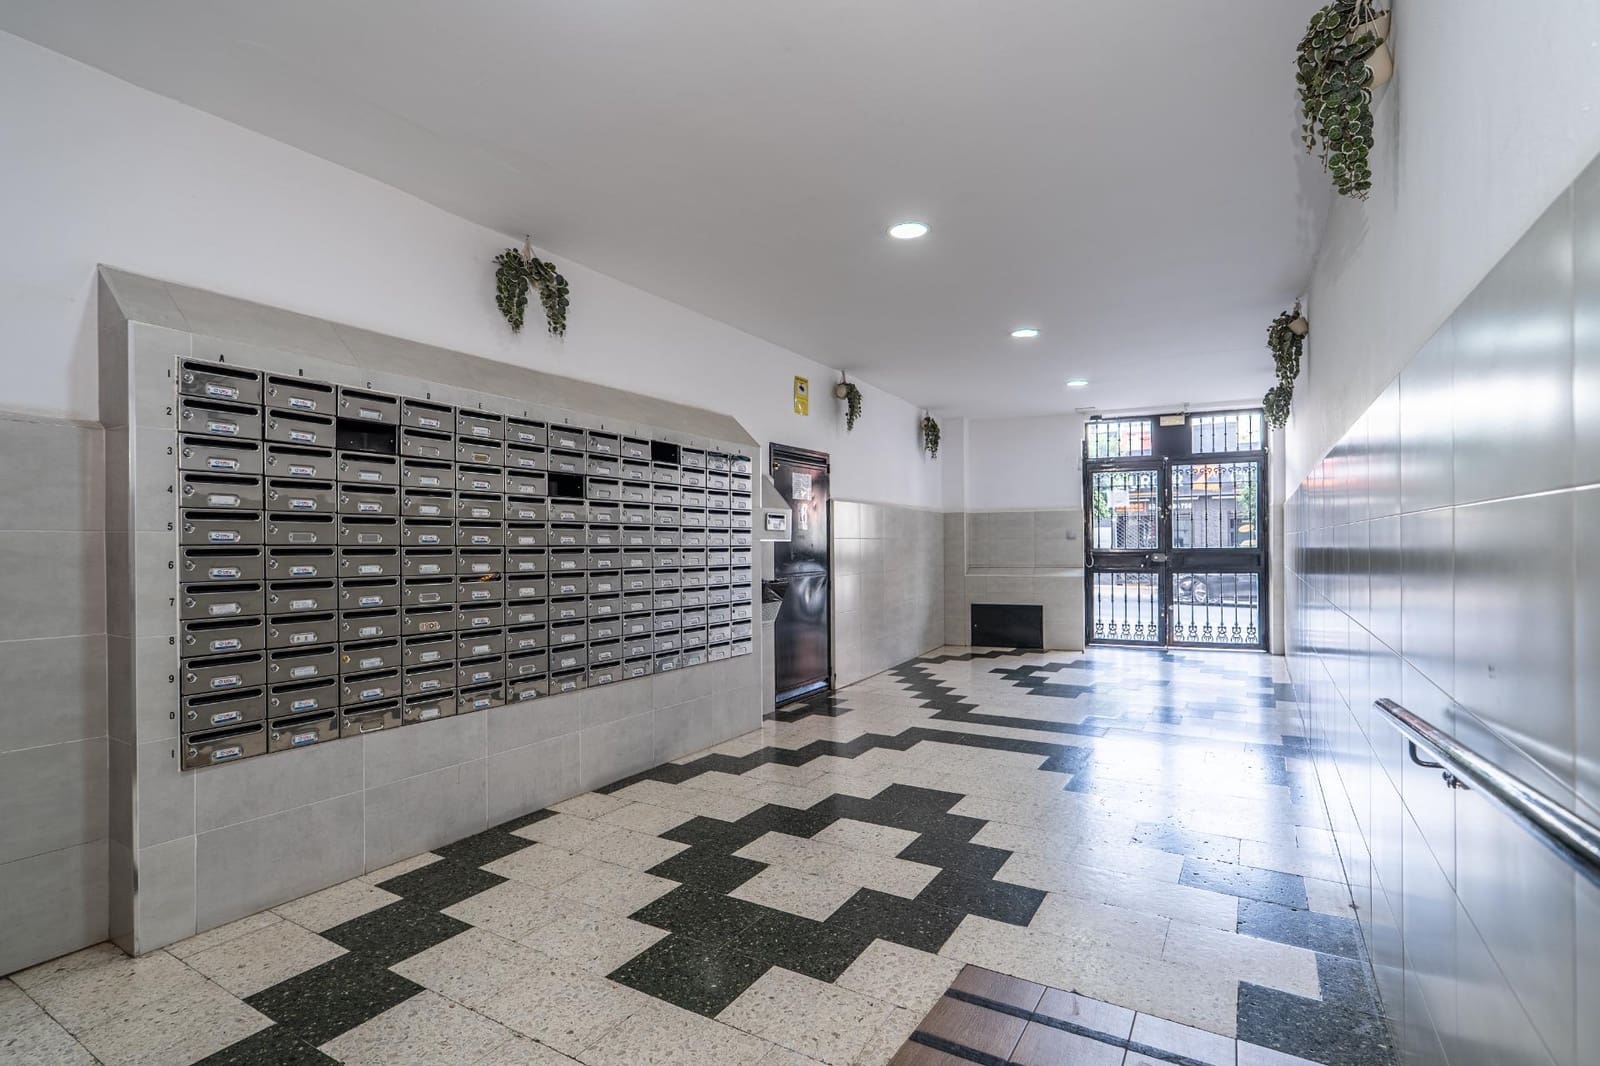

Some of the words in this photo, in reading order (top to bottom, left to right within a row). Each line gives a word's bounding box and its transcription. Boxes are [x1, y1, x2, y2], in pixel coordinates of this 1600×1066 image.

[218, 354, 225, 363] A
[166, 406, 173, 416] 2
[167, 446, 173, 456] 3
[167, 485, 173, 494] 4
[167, 522, 174, 531] 5
[168, 561, 174, 570] 6
[168, 598, 175, 607] 7
[169, 636, 175, 646] 8
[168, 674, 175, 684] 9
